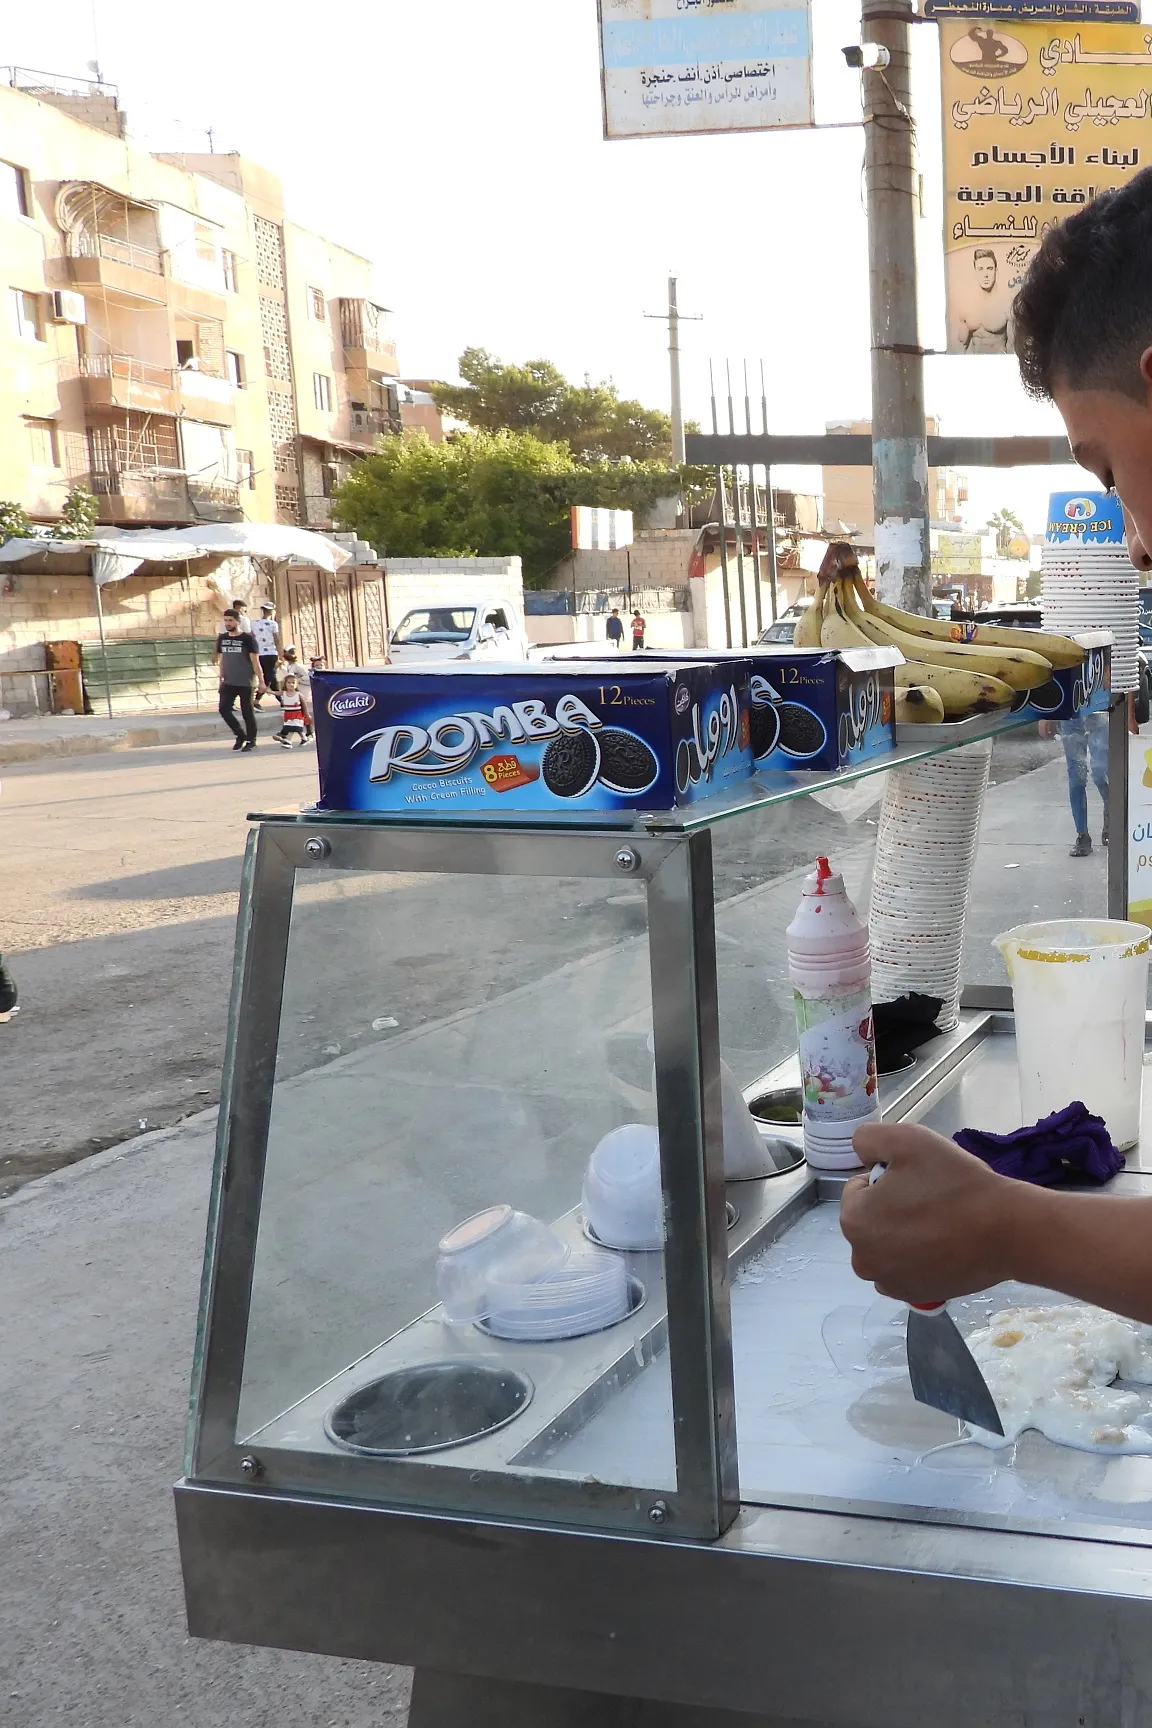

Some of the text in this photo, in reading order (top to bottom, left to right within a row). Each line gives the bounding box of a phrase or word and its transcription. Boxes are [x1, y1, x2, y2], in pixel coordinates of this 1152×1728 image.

[1019, 2, 1055, 15] العريض
[1056, 2, 1088, 15] الشارع
[684, 87, 712, 107] والعنق
[743, 82, 776, 106] وأمراض
[951, 86, 1060, 130] الرياضي
[971, 142, 1139, 170] لبناء الأجسام
[957, 185, 1042, 207] البدنية
[953, 214, 1038, 240] للنساء
[1049, 519, 1112, 533] ICE CREAM
[779, 667, 799, 685] 12
[799, 676, 825, 685] Pieces
[330, 696, 370, 713] Katakit
[598, 685, 656, 706] 12 Pieces
[350, 694, 603, 783] ROMBA
[484, 764, 498, 783] 8
[498, 770, 520, 779] Pieces
[412, 776, 473, 791] Cocoa Biscuits
[405, 786, 486, 804] With Cream Filling
